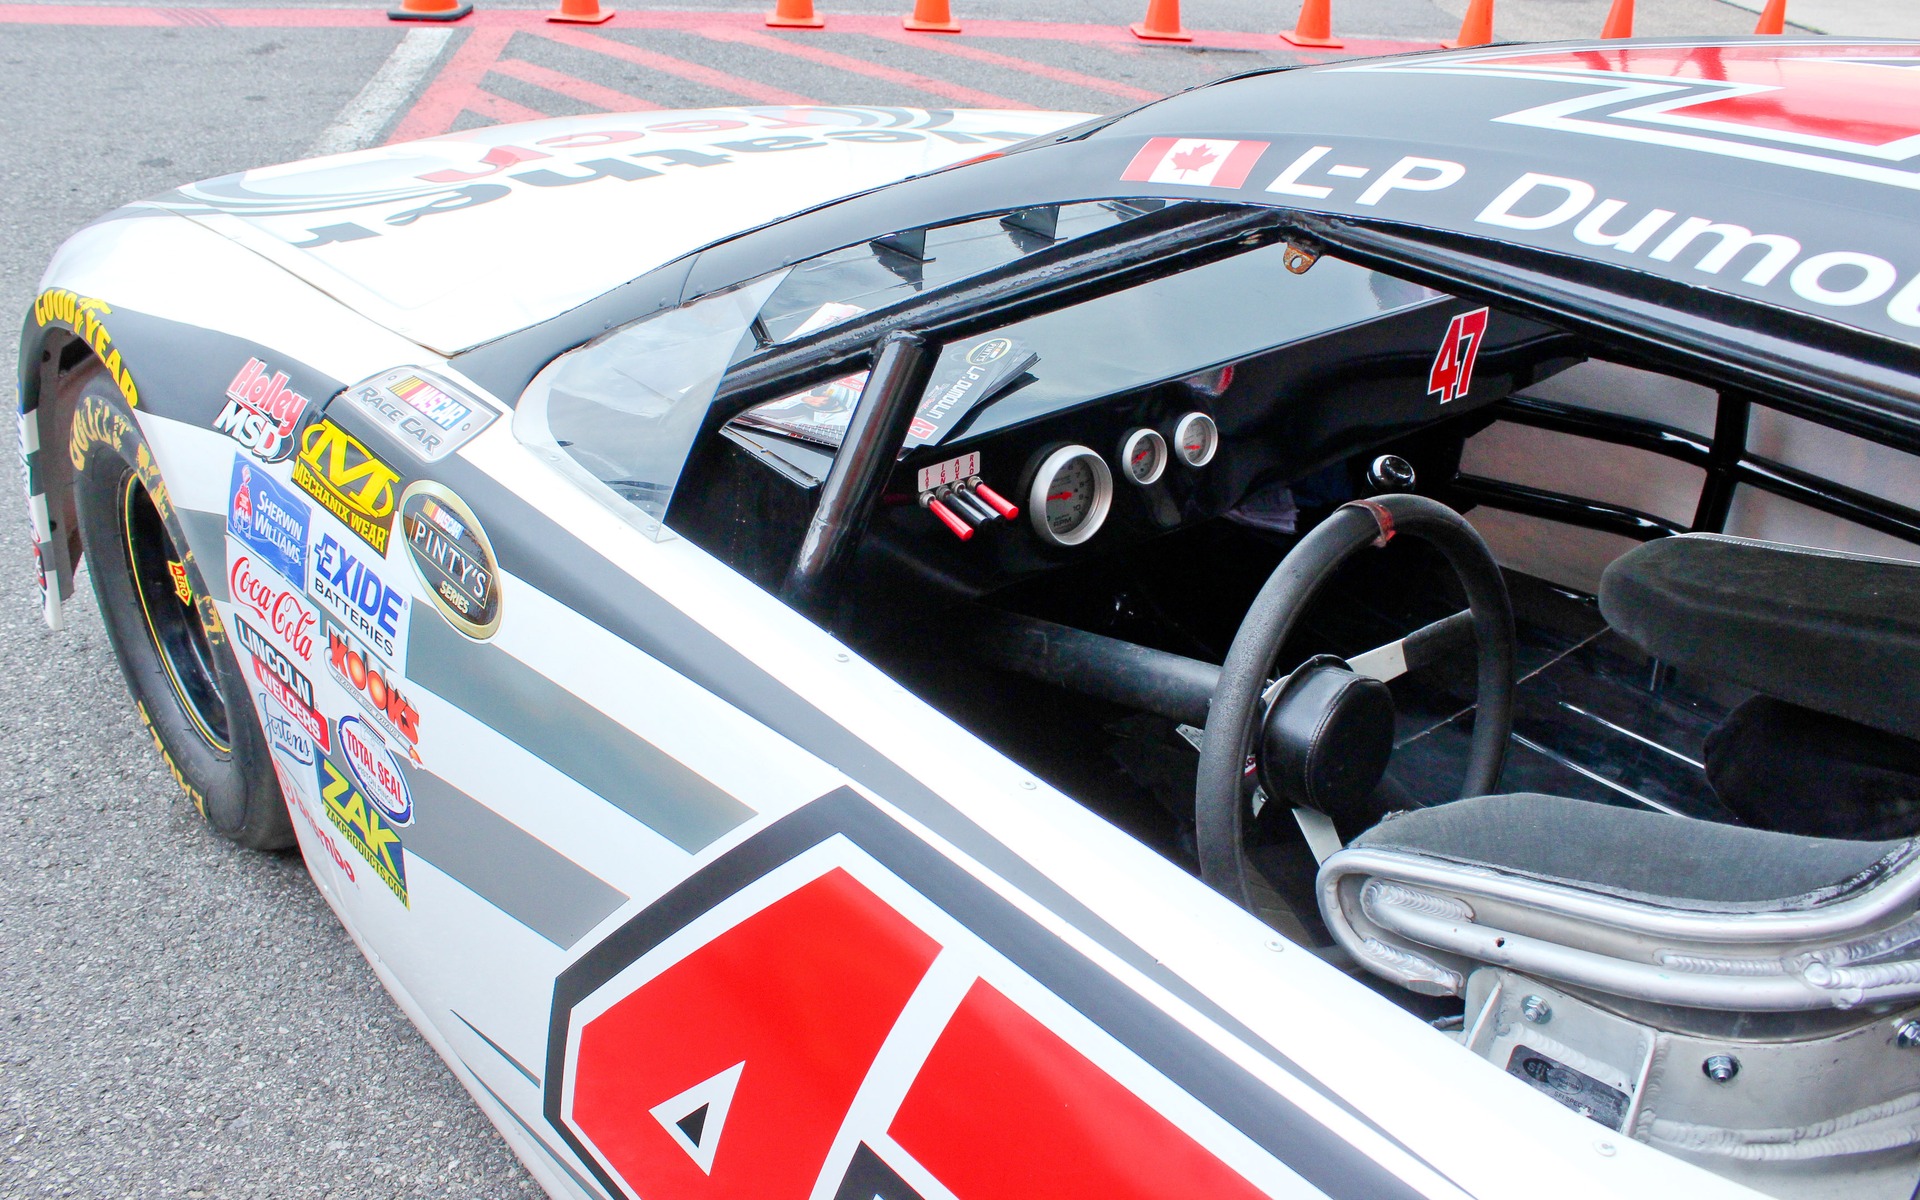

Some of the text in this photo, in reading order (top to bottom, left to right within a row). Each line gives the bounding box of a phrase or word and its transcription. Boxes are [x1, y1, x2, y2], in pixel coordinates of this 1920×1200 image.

[1265, 145, 1466, 206] L-P
[34, 289, 138, 410] GOODYEAR
[1427, 306, 1489, 404] 47
[212, 400, 284, 459] MSD
[226, 357, 310, 437] Holley
[357, 386, 443, 455] RACE CAR
[254, 511, 302, 566] WILLIAMS
[256, 490, 303, 541] SHERWIN
[292, 456, 388, 553] MECHANIX WEAR
[173, 567, 190, 598] AERO
[314, 532, 405, 639] EXIDE
[414, 520, 487, 599] PINTY'S
[439, 580, 470, 614] SERIES
[314, 577, 394, 657] BATTERIES
[237, 618, 313, 708] LINCOLN
[257, 662, 322, 741] WELDERS
[329, 629, 420, 746] KOOKS
[258, 692, 311, 758] Jostens
[345, 727, 377, 777] TOTAL
[377, 760, 404, 807] SEAL
[294, 787, 356, 883] brembo
[322, 758, 401, 883] ZAK
[325, 805, 409, 909] ZAKPRODUCTS.COM
